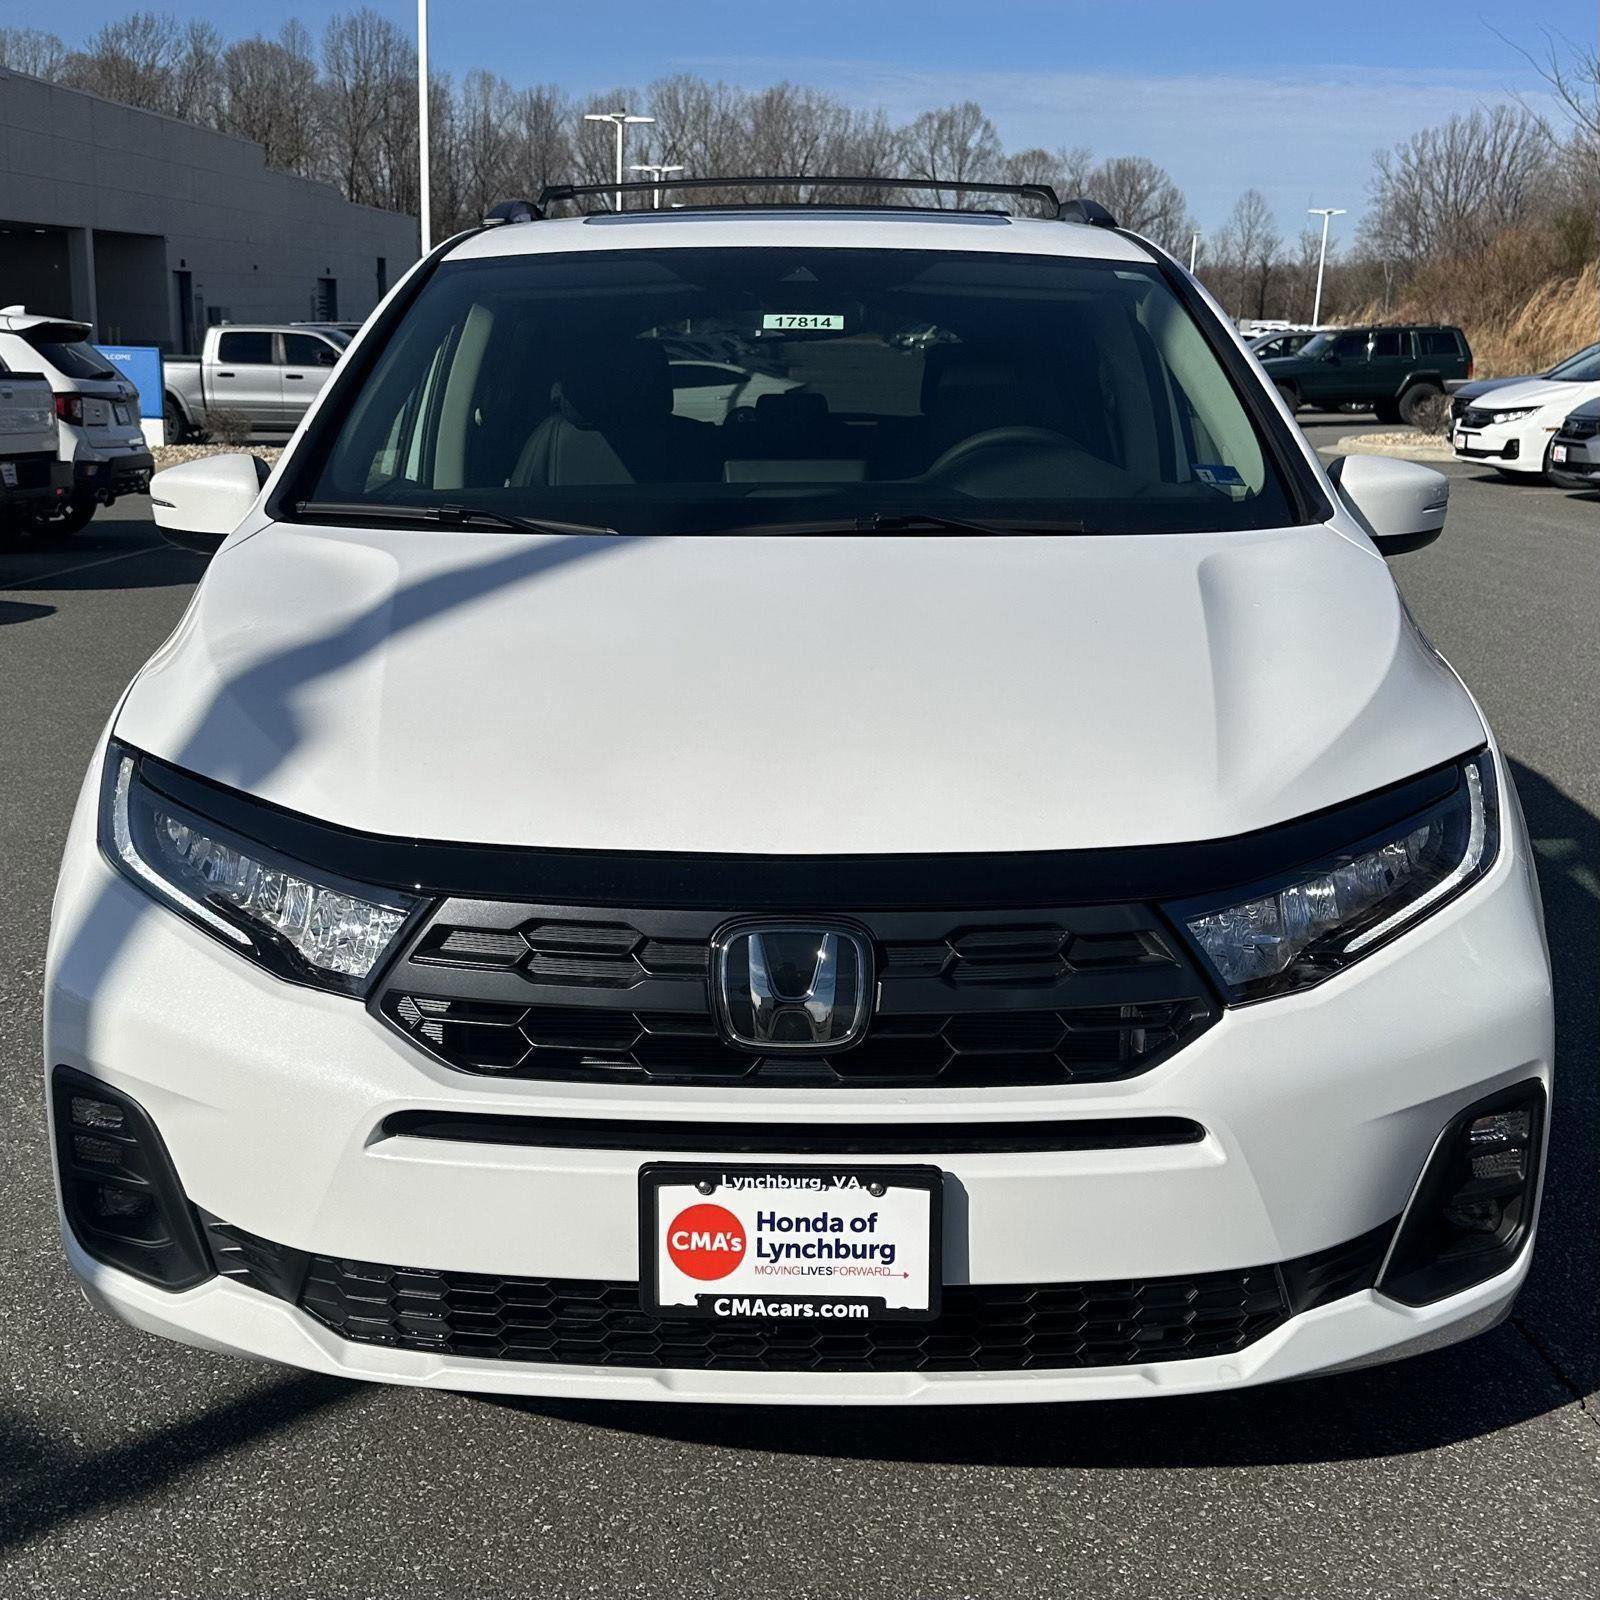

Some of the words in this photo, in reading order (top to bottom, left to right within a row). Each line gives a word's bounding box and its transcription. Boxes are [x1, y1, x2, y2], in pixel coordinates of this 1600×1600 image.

[775, 316, 832, 328] 17814
[721, 1174, 828, 1192] Lynchburg,
[756, 1210, 844, 1233] Honda
[849, 1211, 879, 1233] of
[671, 1230, 743, 1252] CMA's
[756, 1236, 896, 1265] Lynchburg
[713, 1298, 870, 1319] CMAcars.com
